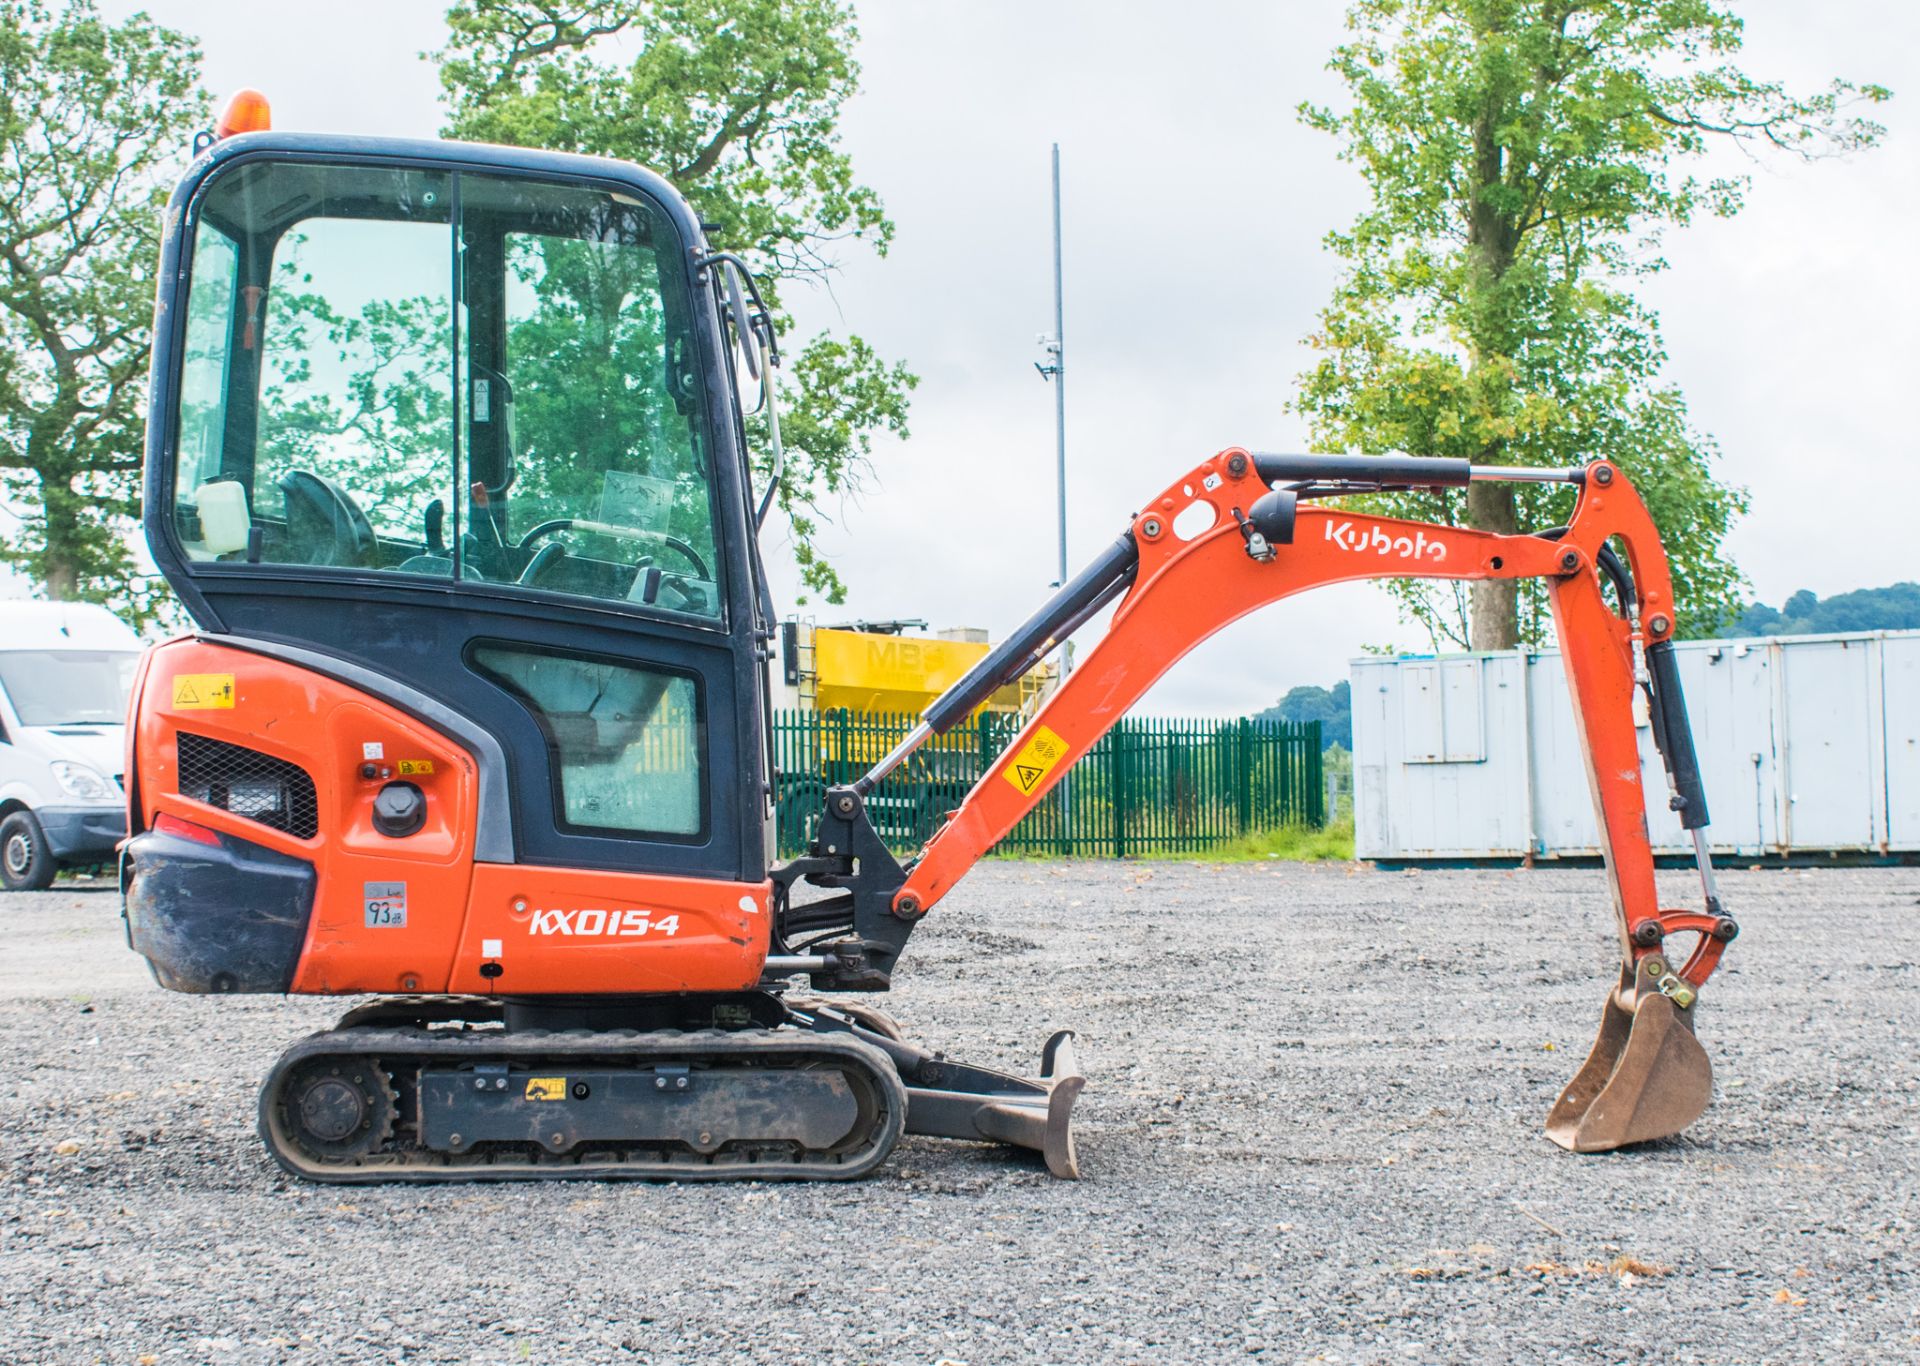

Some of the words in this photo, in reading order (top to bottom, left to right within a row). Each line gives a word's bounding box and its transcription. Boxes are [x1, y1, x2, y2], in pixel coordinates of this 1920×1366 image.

[1325, 520, 1447, 562] Kubota
[369, 902, 390, 924] 93
[529, 909, 680, 935] KX015-4
